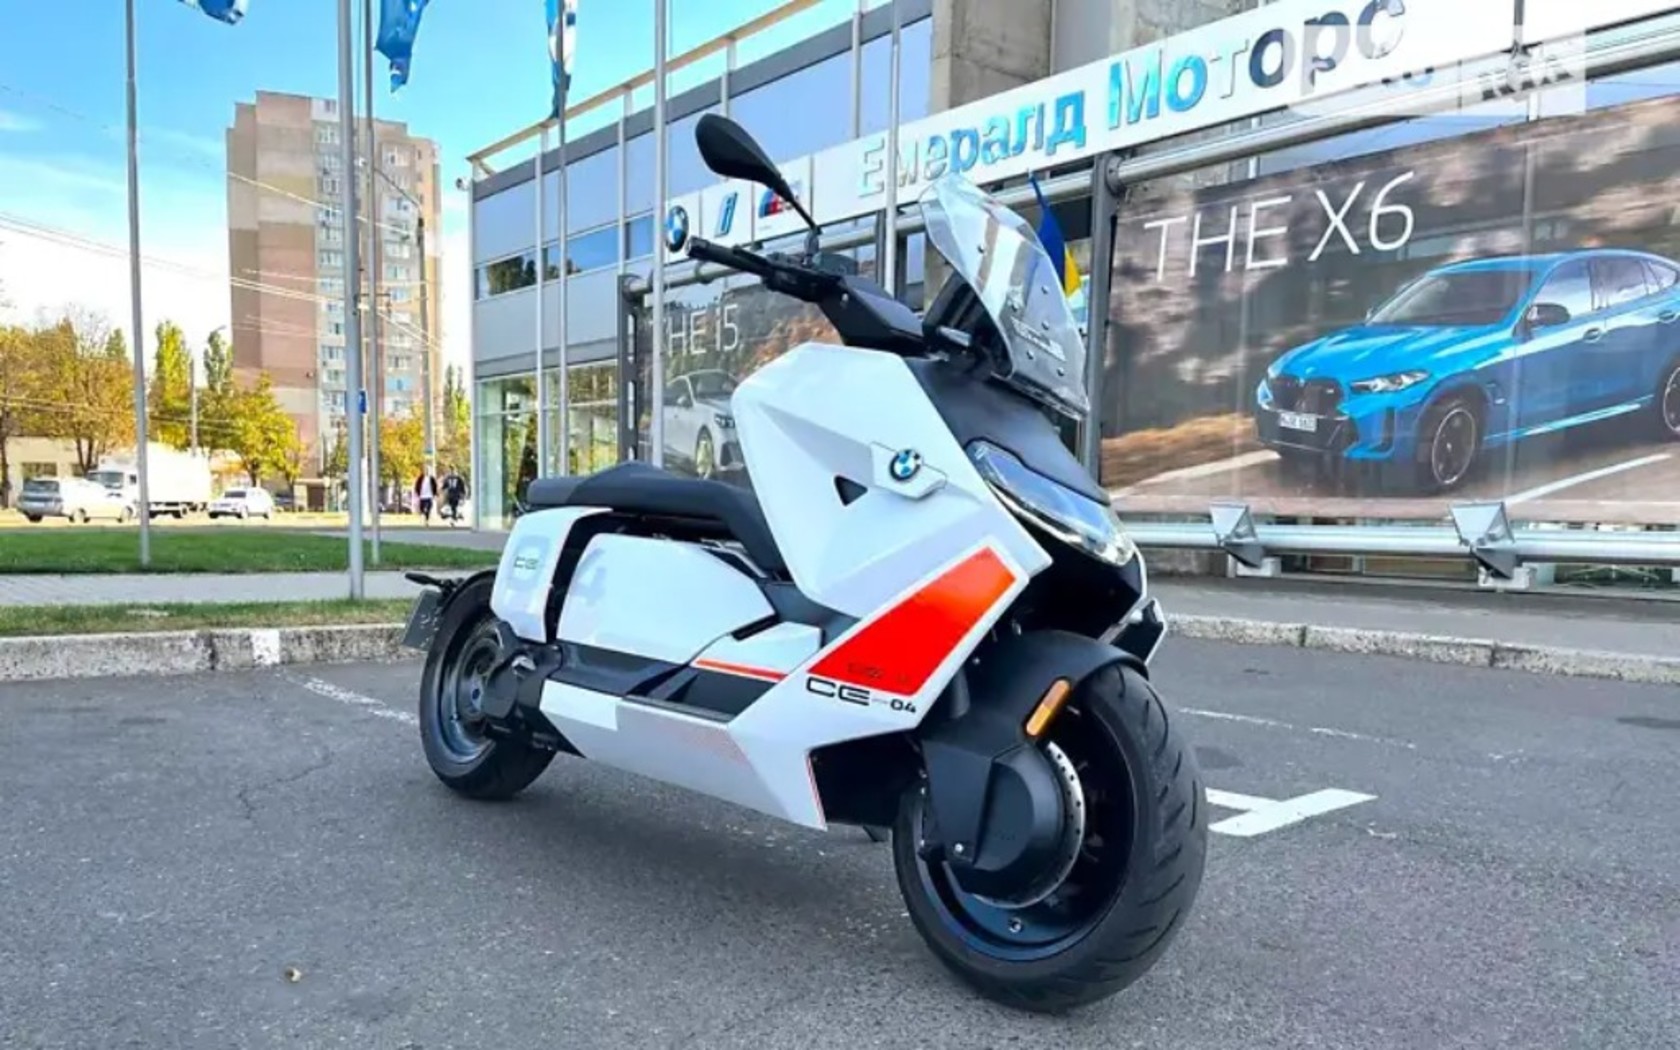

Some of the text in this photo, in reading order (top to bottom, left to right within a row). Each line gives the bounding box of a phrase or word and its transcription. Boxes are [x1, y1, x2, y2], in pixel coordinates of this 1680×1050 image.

[857, 0, 1405, 198] Емералд Моторс
[1143, 171, 1415, 282] THE X6
[650, 309, 707, 357] HE
